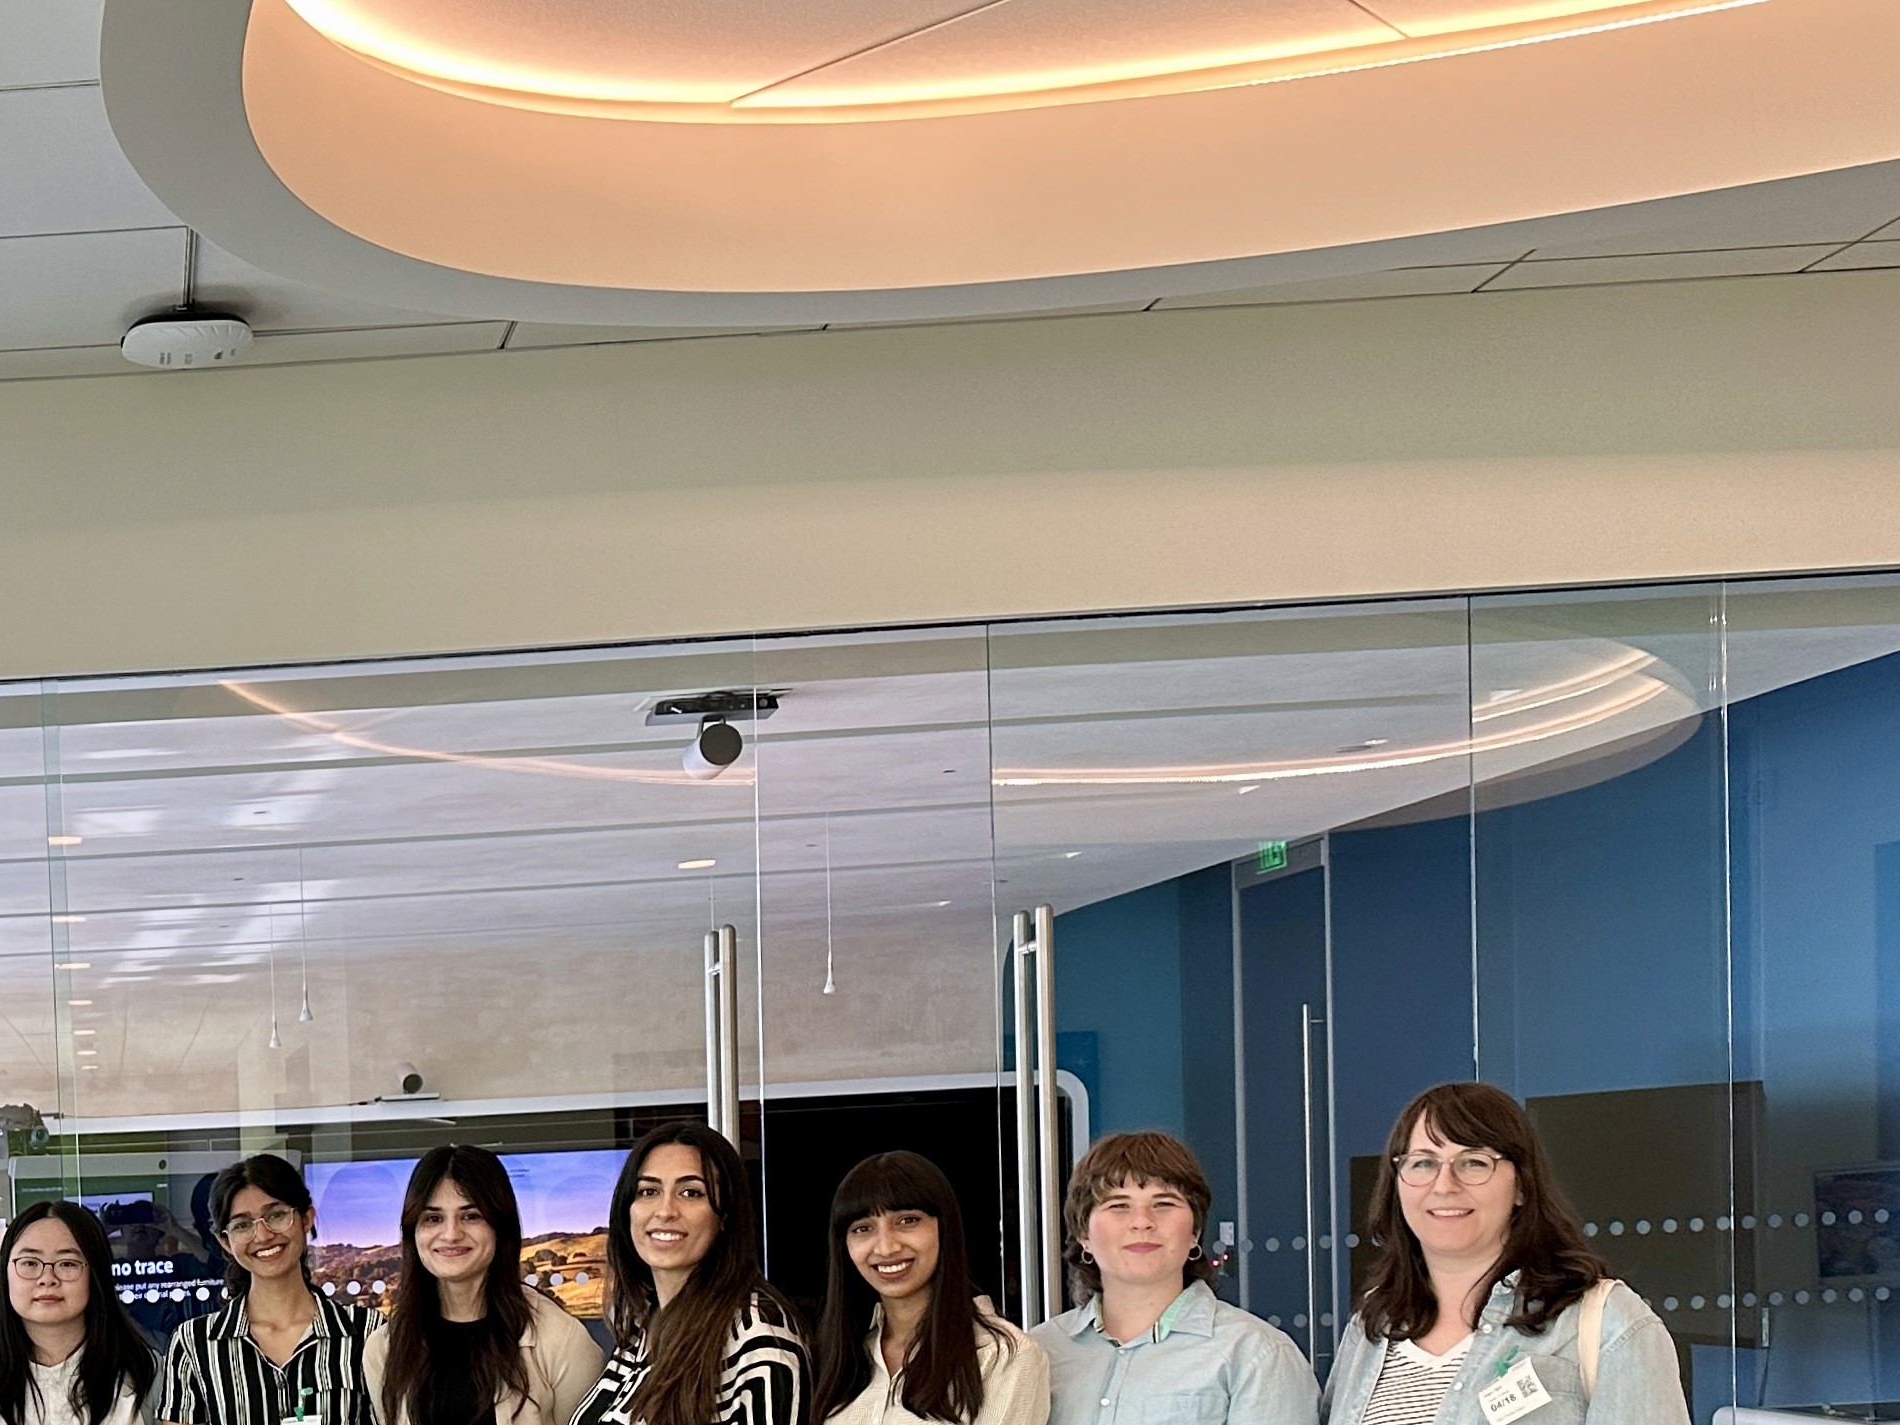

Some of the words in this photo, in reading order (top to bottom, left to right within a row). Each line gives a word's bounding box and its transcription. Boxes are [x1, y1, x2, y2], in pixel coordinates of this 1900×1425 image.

[111, 1262, 131, 1276] no
[134, 1260, 174, 1275] trace
[135, 1282, 147, 1292] put
[1490, 1393, 1517, 1412] 04/18
